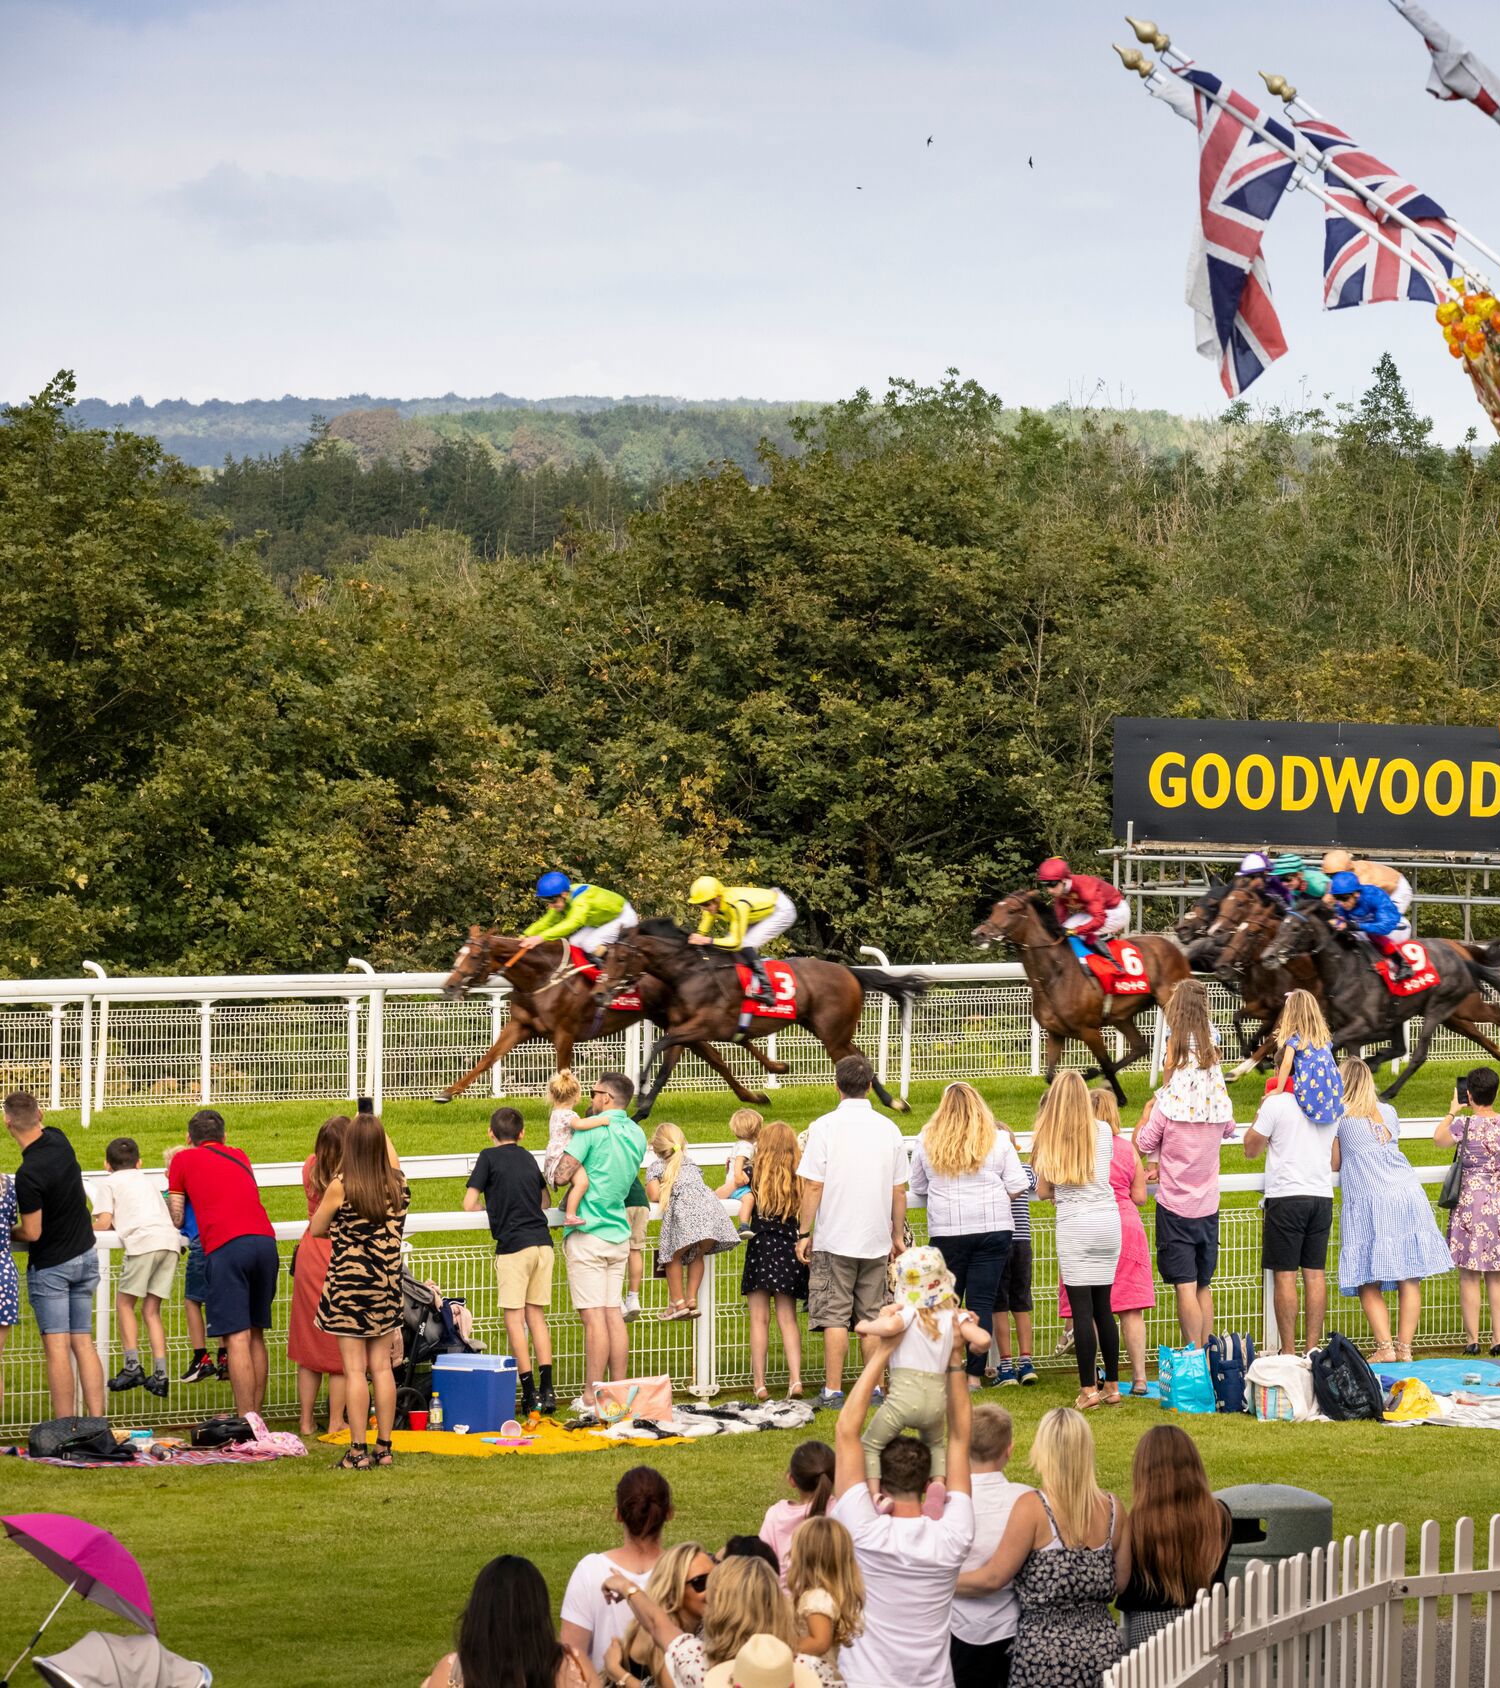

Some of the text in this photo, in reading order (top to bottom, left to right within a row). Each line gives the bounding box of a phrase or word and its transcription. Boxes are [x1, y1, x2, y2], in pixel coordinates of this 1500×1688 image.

[1121, 947, 1144, 976] 6
[1401, 943, 1427, 972] 9
[774, 971, 796, 1001] 3
